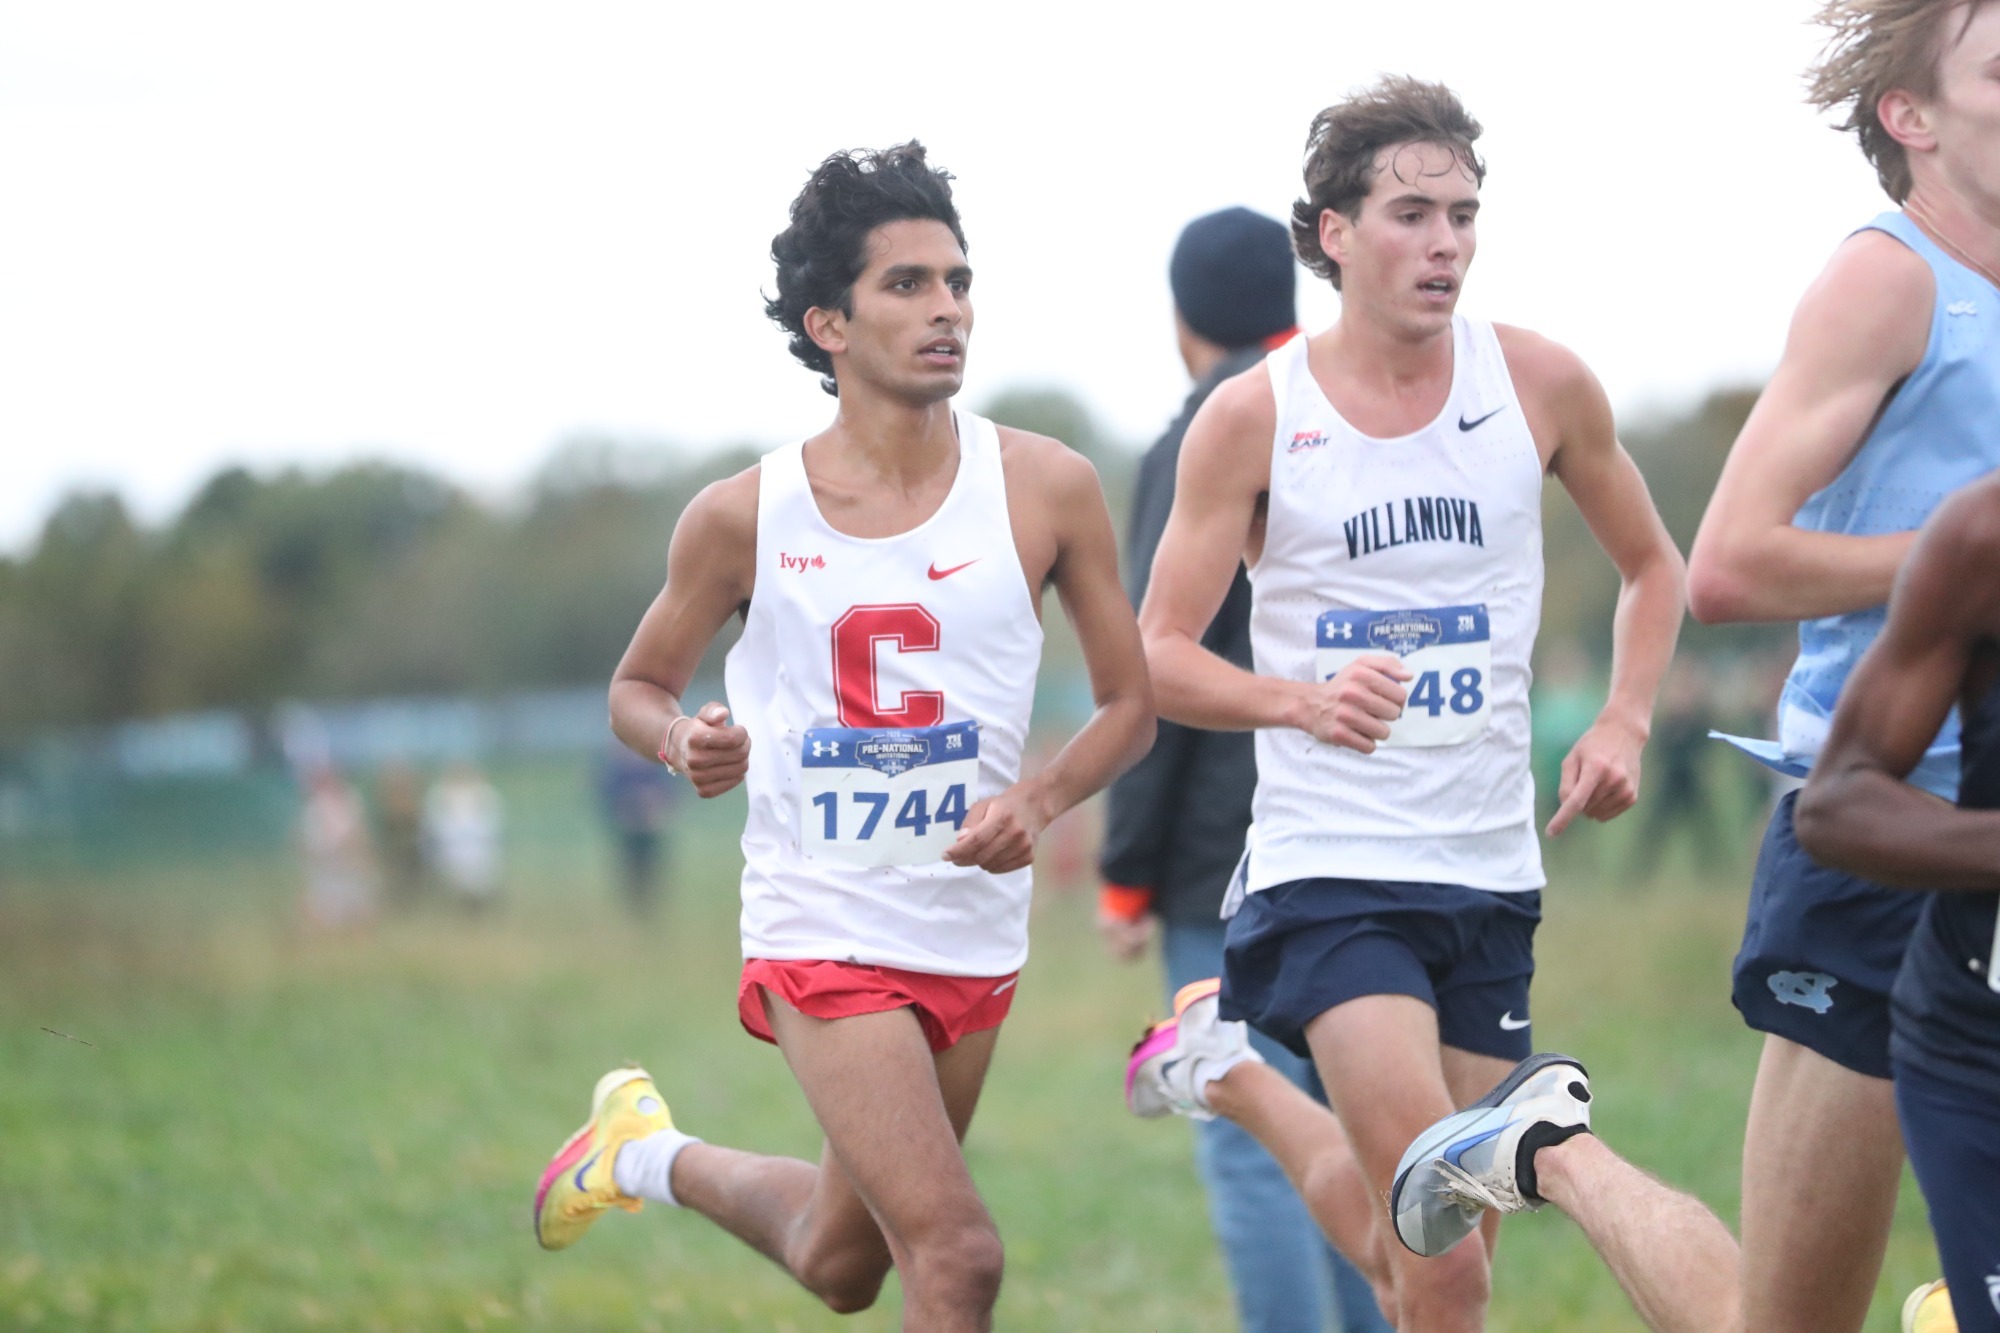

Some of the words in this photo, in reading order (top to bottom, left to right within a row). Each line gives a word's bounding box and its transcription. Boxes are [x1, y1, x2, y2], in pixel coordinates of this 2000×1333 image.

[1343, 496, 1485, 561] VILLANOVA
[779, 552, 809, 574] Ivy
[1373, 622, 1436, 637] PRE-NATIONAL
[831, 602, 944, 729] C
[862, 743, 924, 755] PRE-NATIONAL
[875, 752, 911, 760] INVITATIONAL
[812, 783, 970, 841] 1744
